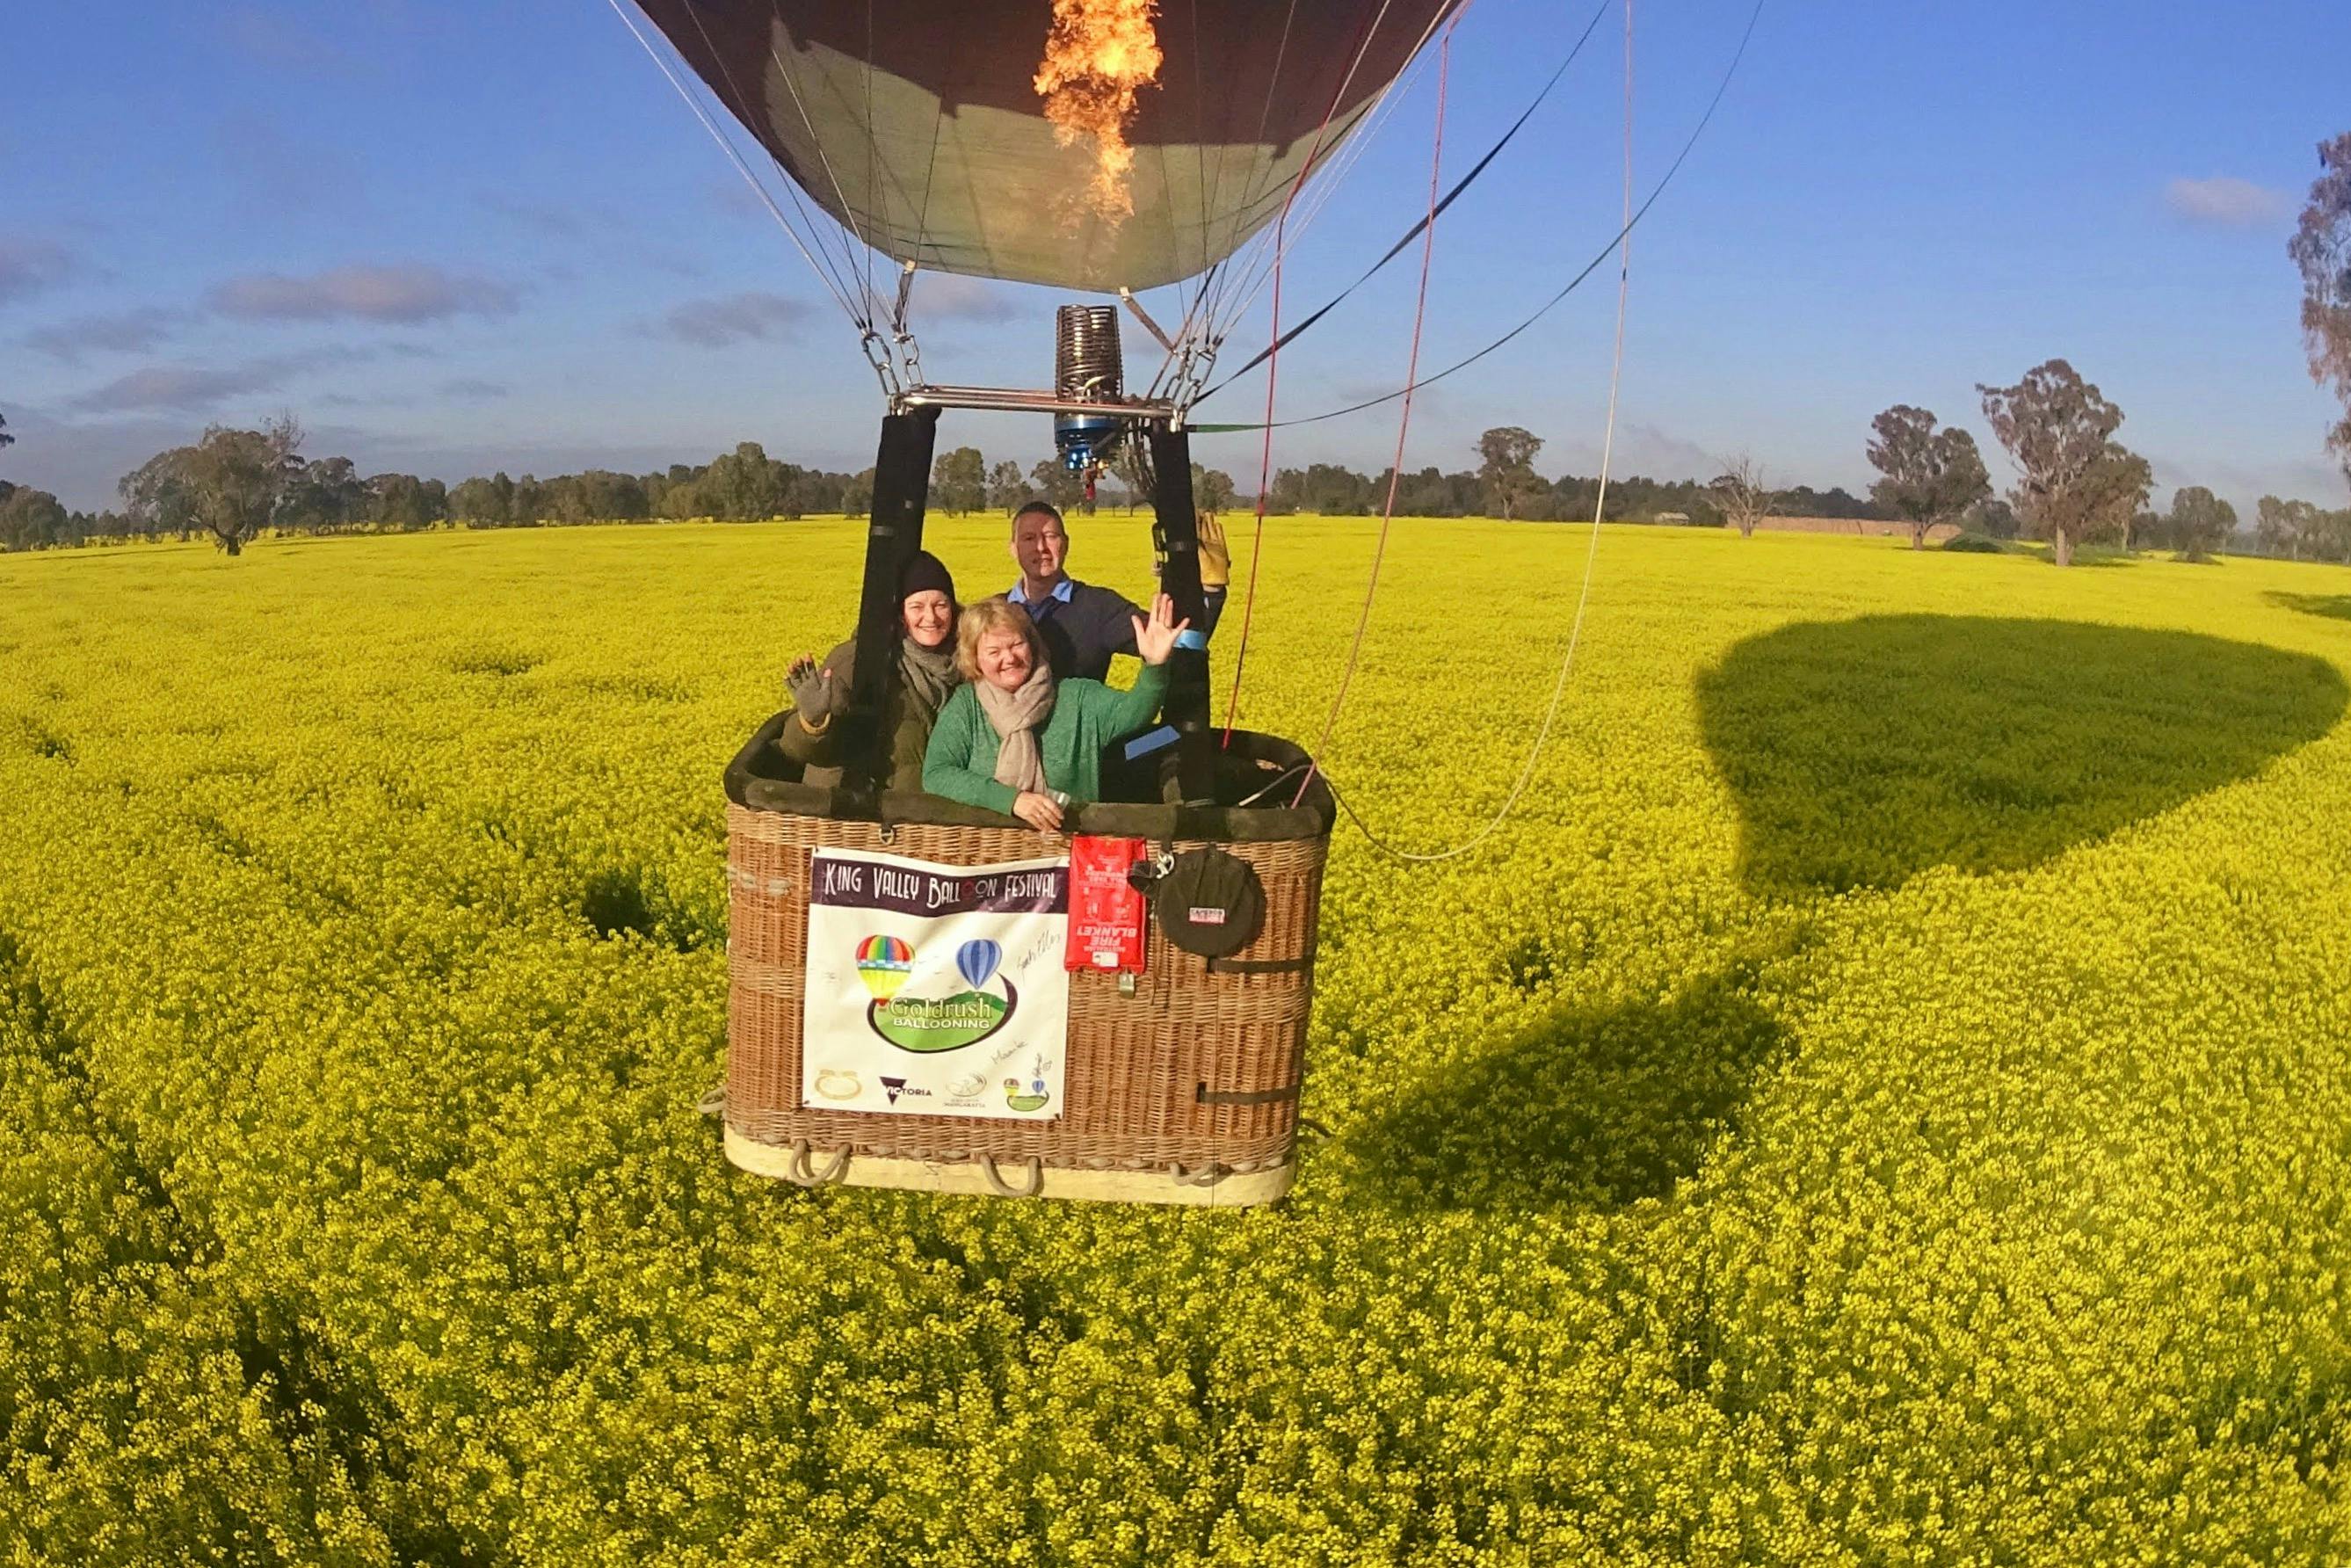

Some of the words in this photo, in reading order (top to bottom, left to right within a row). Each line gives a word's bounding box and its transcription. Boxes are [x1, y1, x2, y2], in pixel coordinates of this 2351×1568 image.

[824, 863, 862, 896] KING
[873, 867, 920, 901] VALLEY
[1005, 872, 1057, 903] FESTIVAL
[1076, 926, 1138, 938] BLANKET
[1089, 936, 1121, 947] FIRE
[889, 997, 992, 1019] Goldrush
[893, 1018, 990, 1029] BALLOONING
